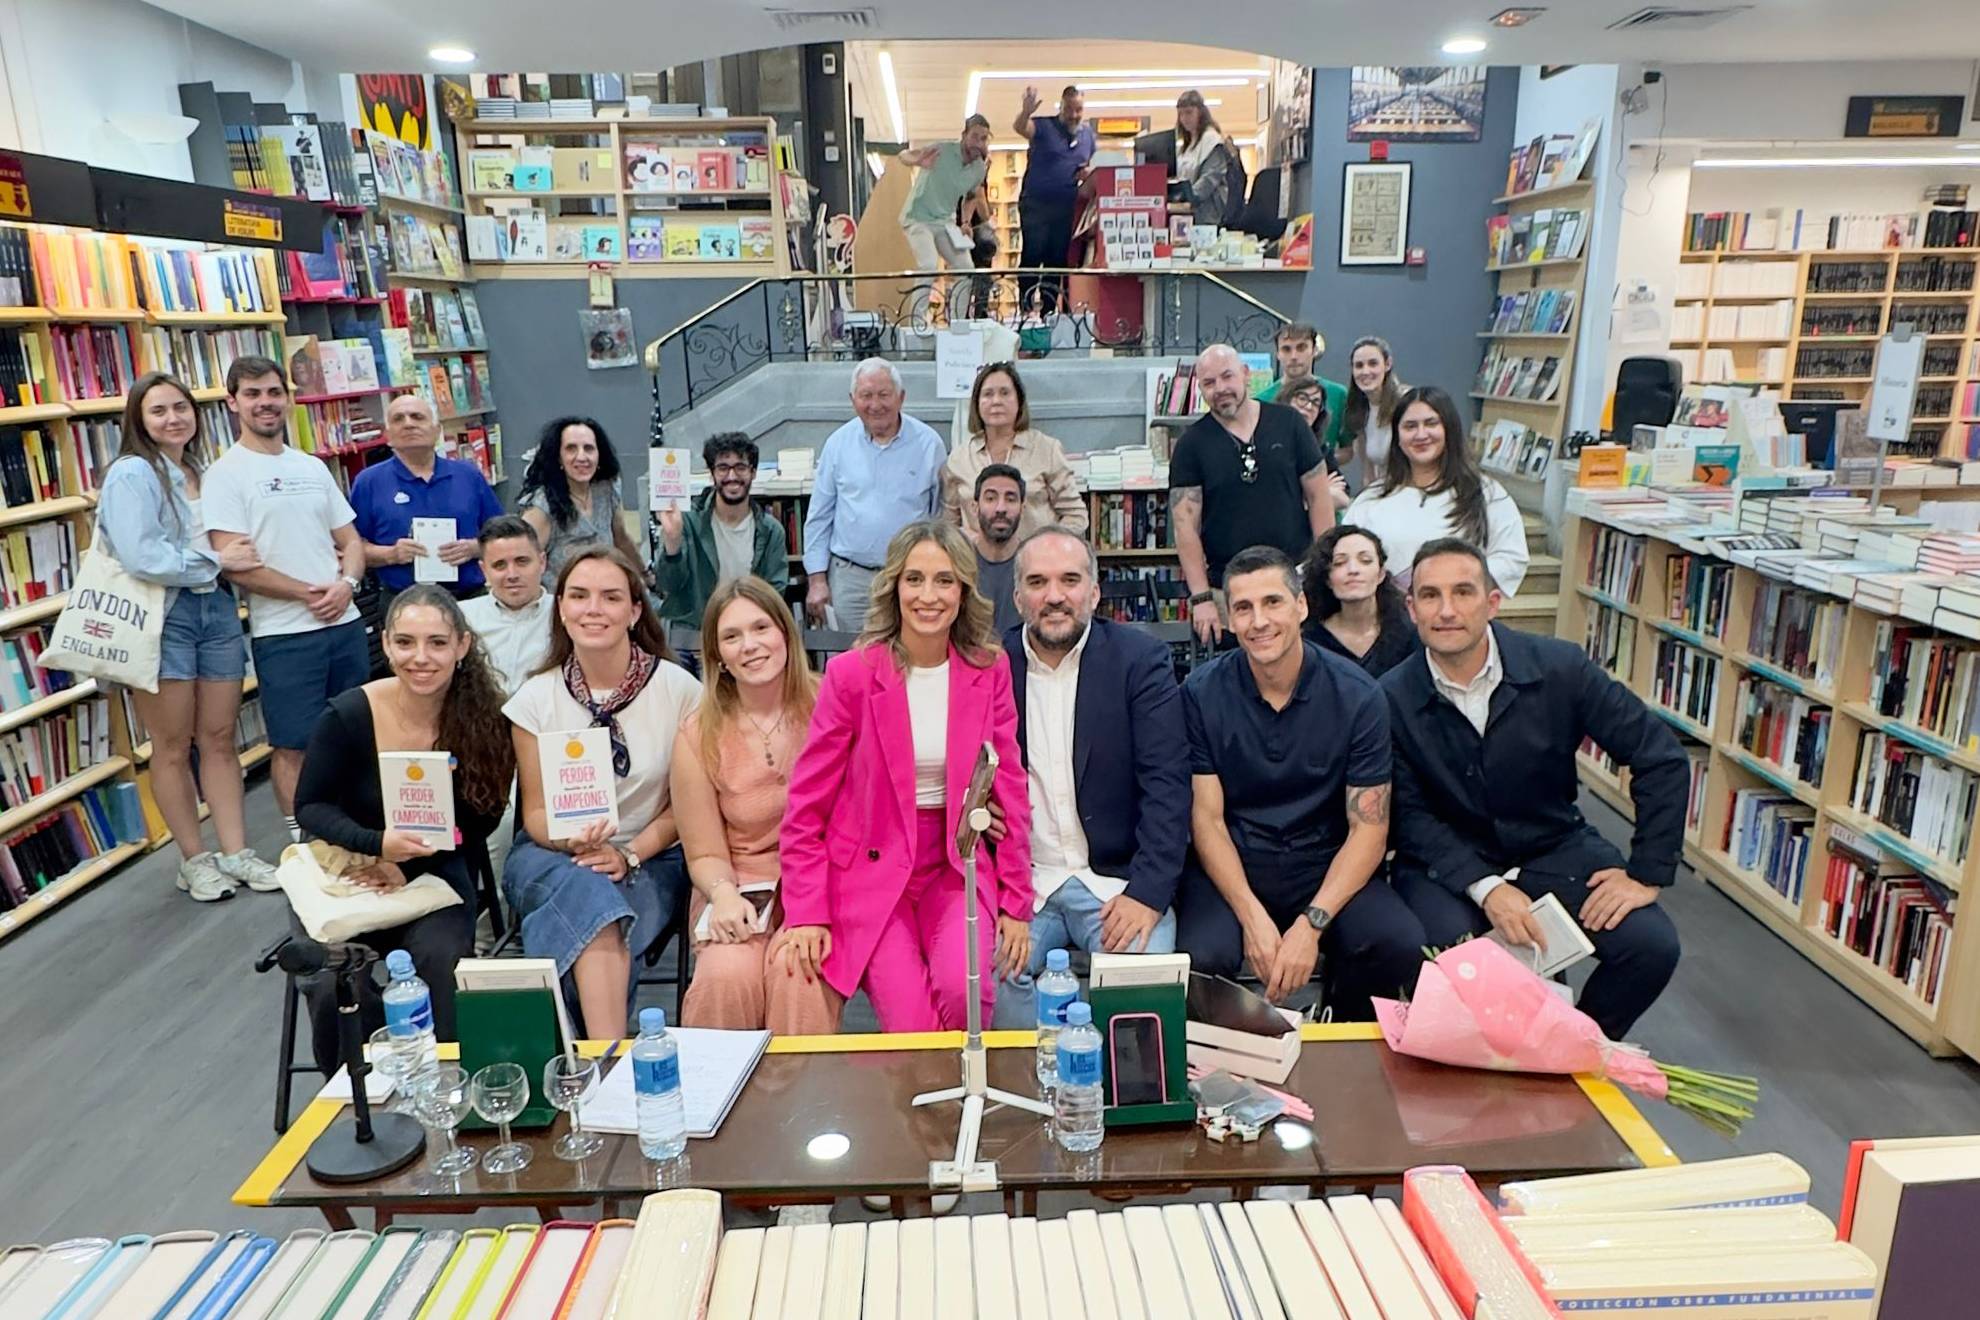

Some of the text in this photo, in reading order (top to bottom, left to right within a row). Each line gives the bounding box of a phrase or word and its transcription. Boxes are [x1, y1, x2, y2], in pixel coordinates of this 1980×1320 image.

[65, 588, 148, 632] LONDON
[61, 635, 129, 664] ENGLAND
[559, 766, 596, 784] PERDER
[399, 788, 435, 803] PERDER
[552, 790, 610, 811] CAMPEONES
[392, 810, 447, 825] CAMPEONES
[1556, 1290, 1857, 1310] COLECCIÓN OBRA FUNDAMENTAL
